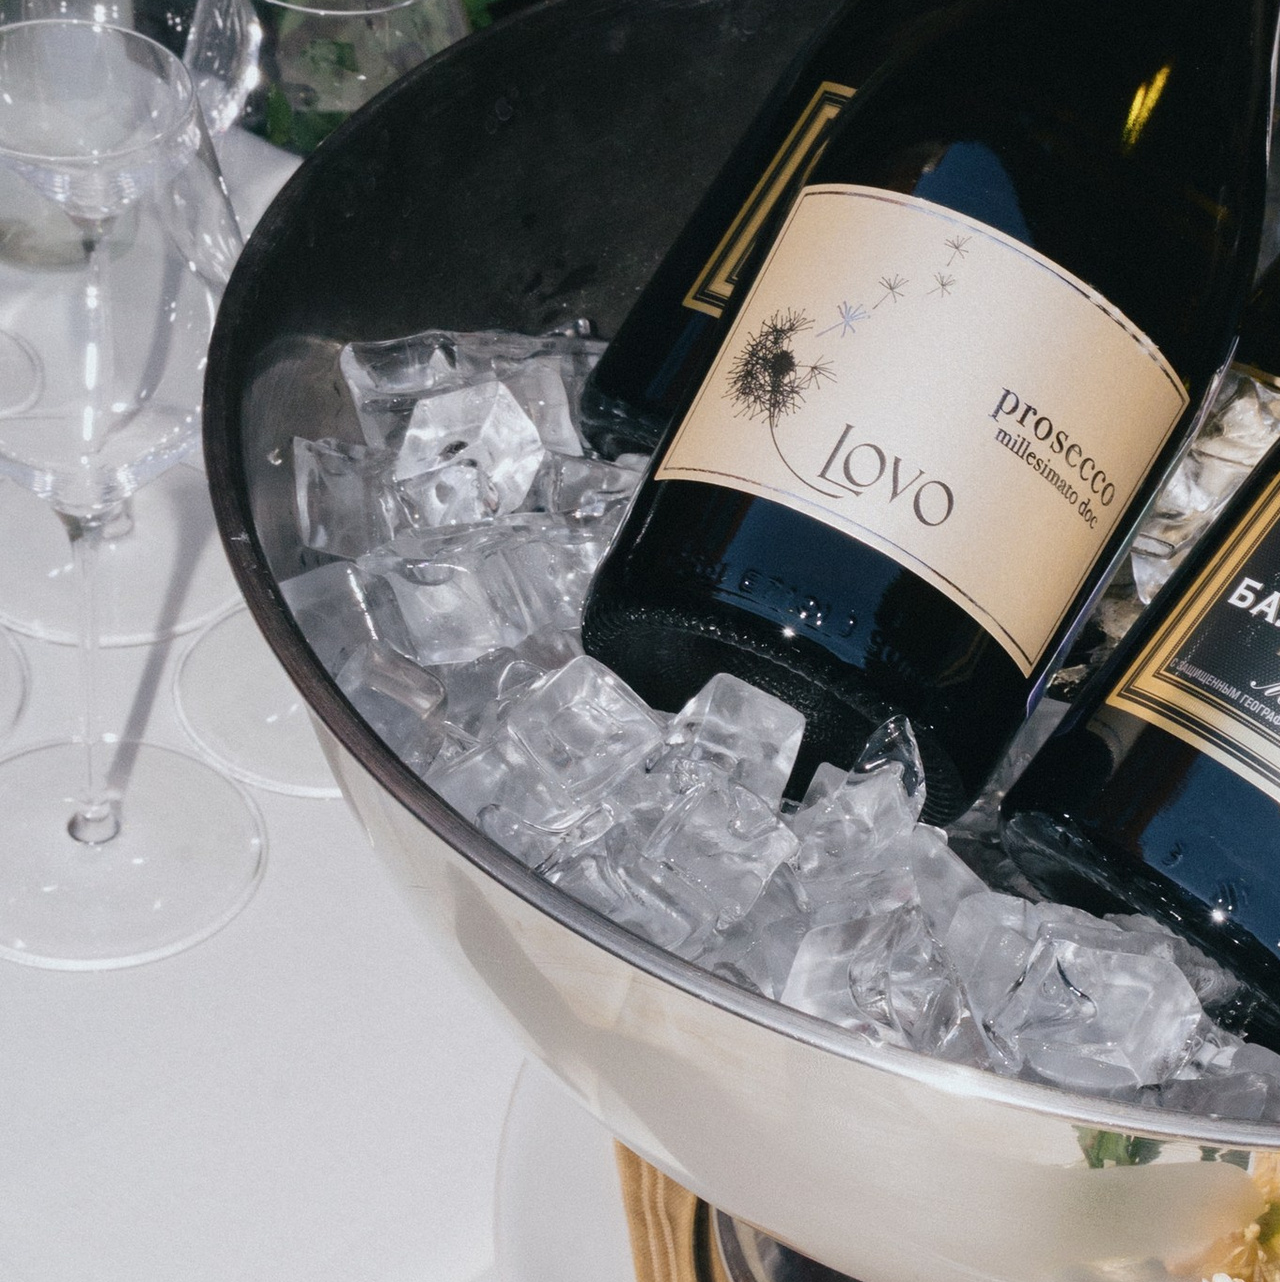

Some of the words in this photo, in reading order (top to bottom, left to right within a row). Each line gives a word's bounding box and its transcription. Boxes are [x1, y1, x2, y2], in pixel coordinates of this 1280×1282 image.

[816, 423, 955, 527] LOVO
[988, 387, 1116, 507] prosecco
[994, 428, 1079, 505] millesimato
[1078, 497, 1099, 530] doc
[1176, 660, 1241, 700] ЗАЩИЩЕННЫМ
